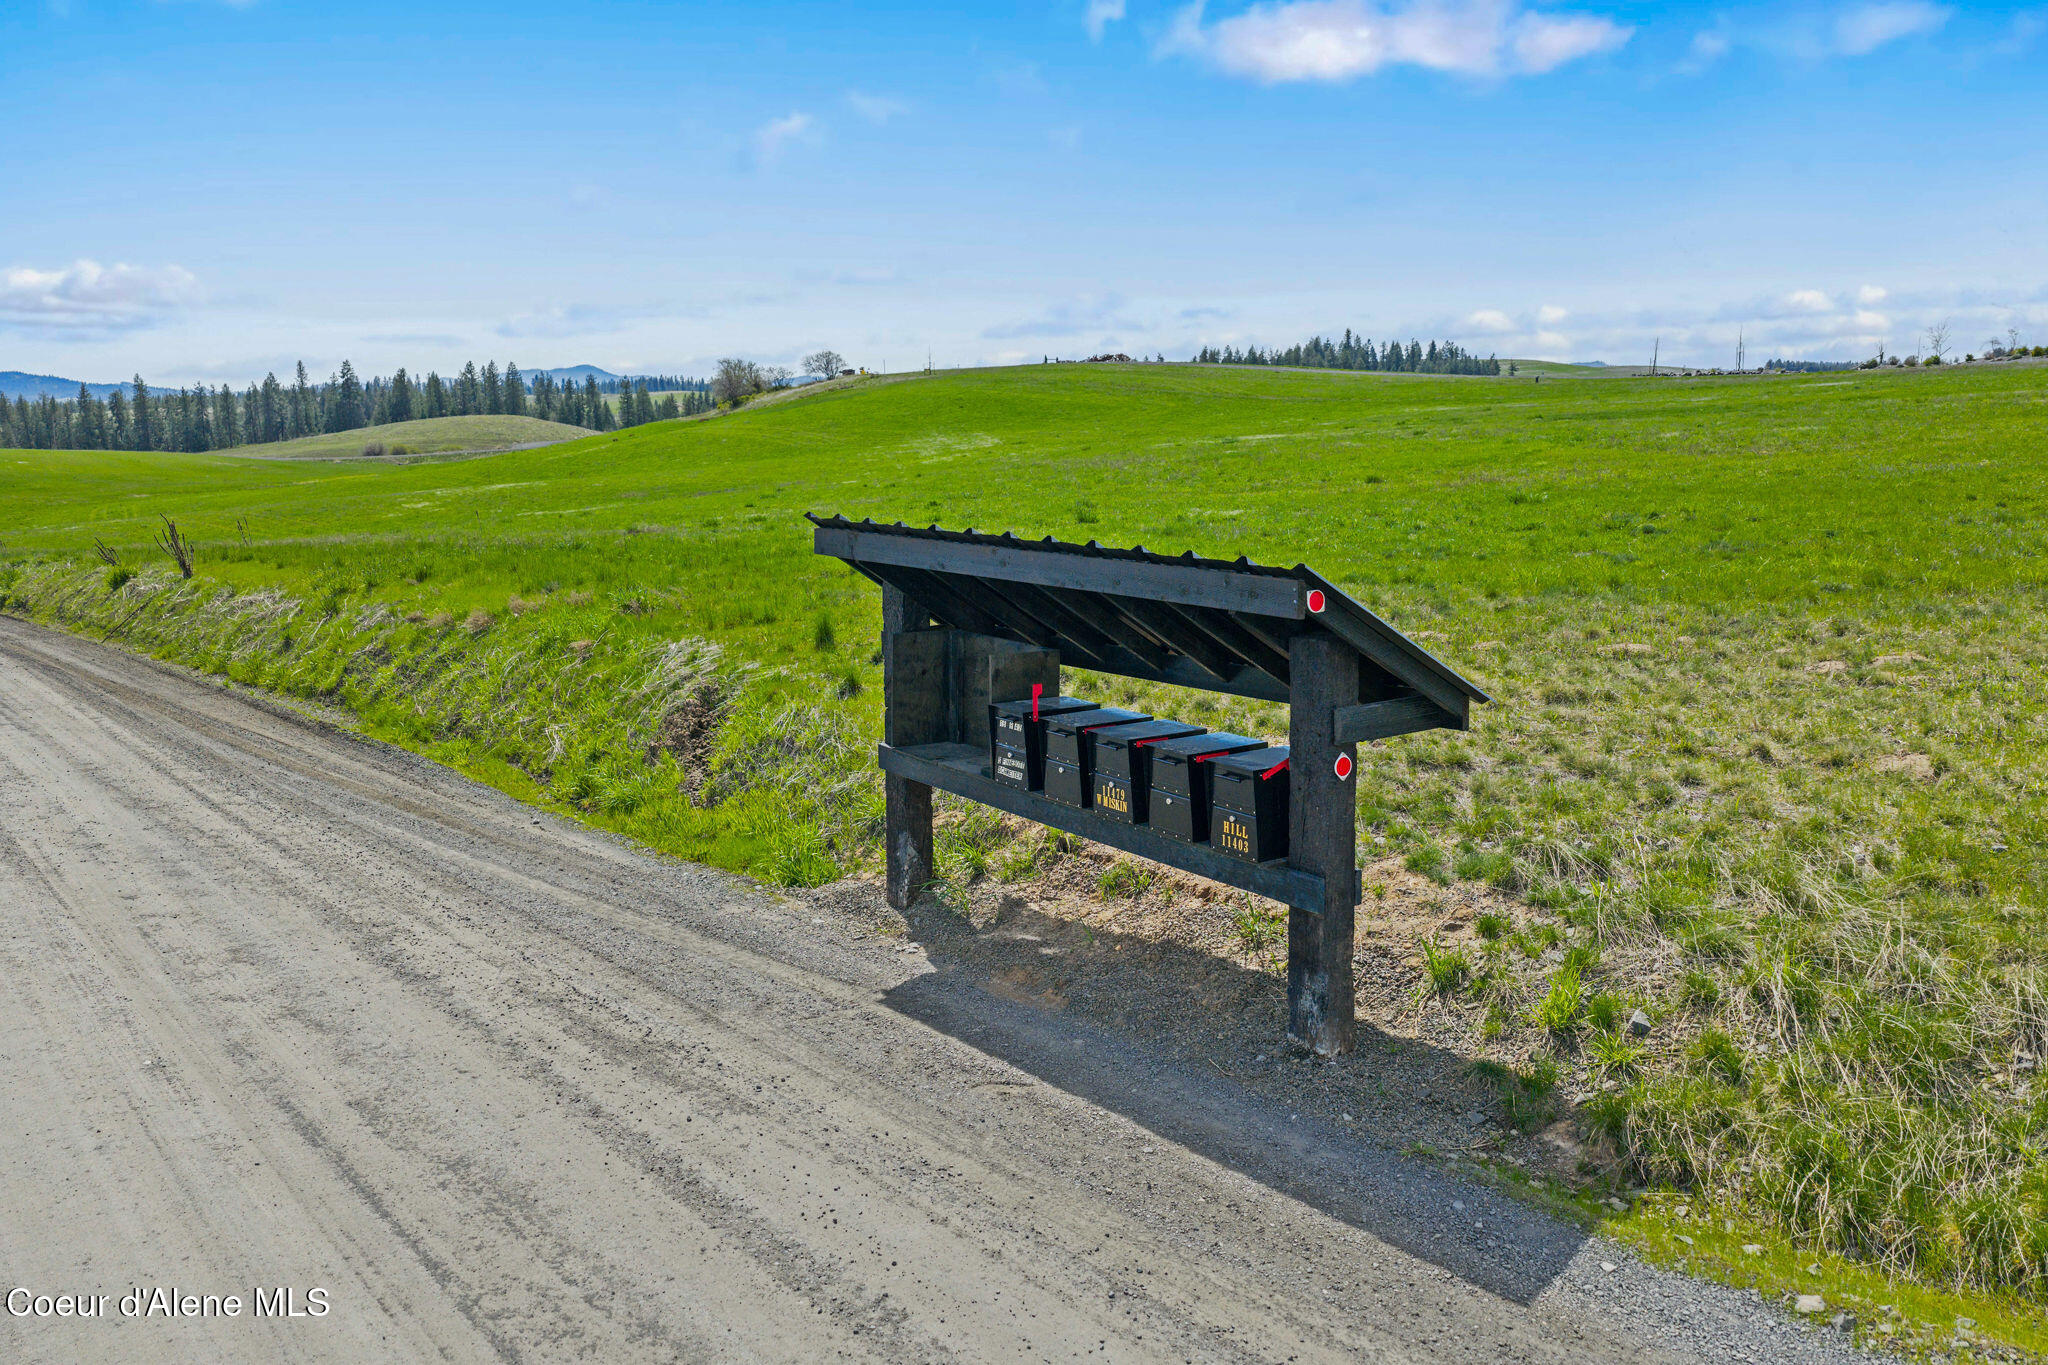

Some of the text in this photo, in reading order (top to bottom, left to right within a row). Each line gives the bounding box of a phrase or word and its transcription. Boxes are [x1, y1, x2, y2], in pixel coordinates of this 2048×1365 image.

[1102, 785, 1125, 801] 11479
[1223, 820, 1249, 839] HILL
[1222, 834, 1249, 853] 11403
